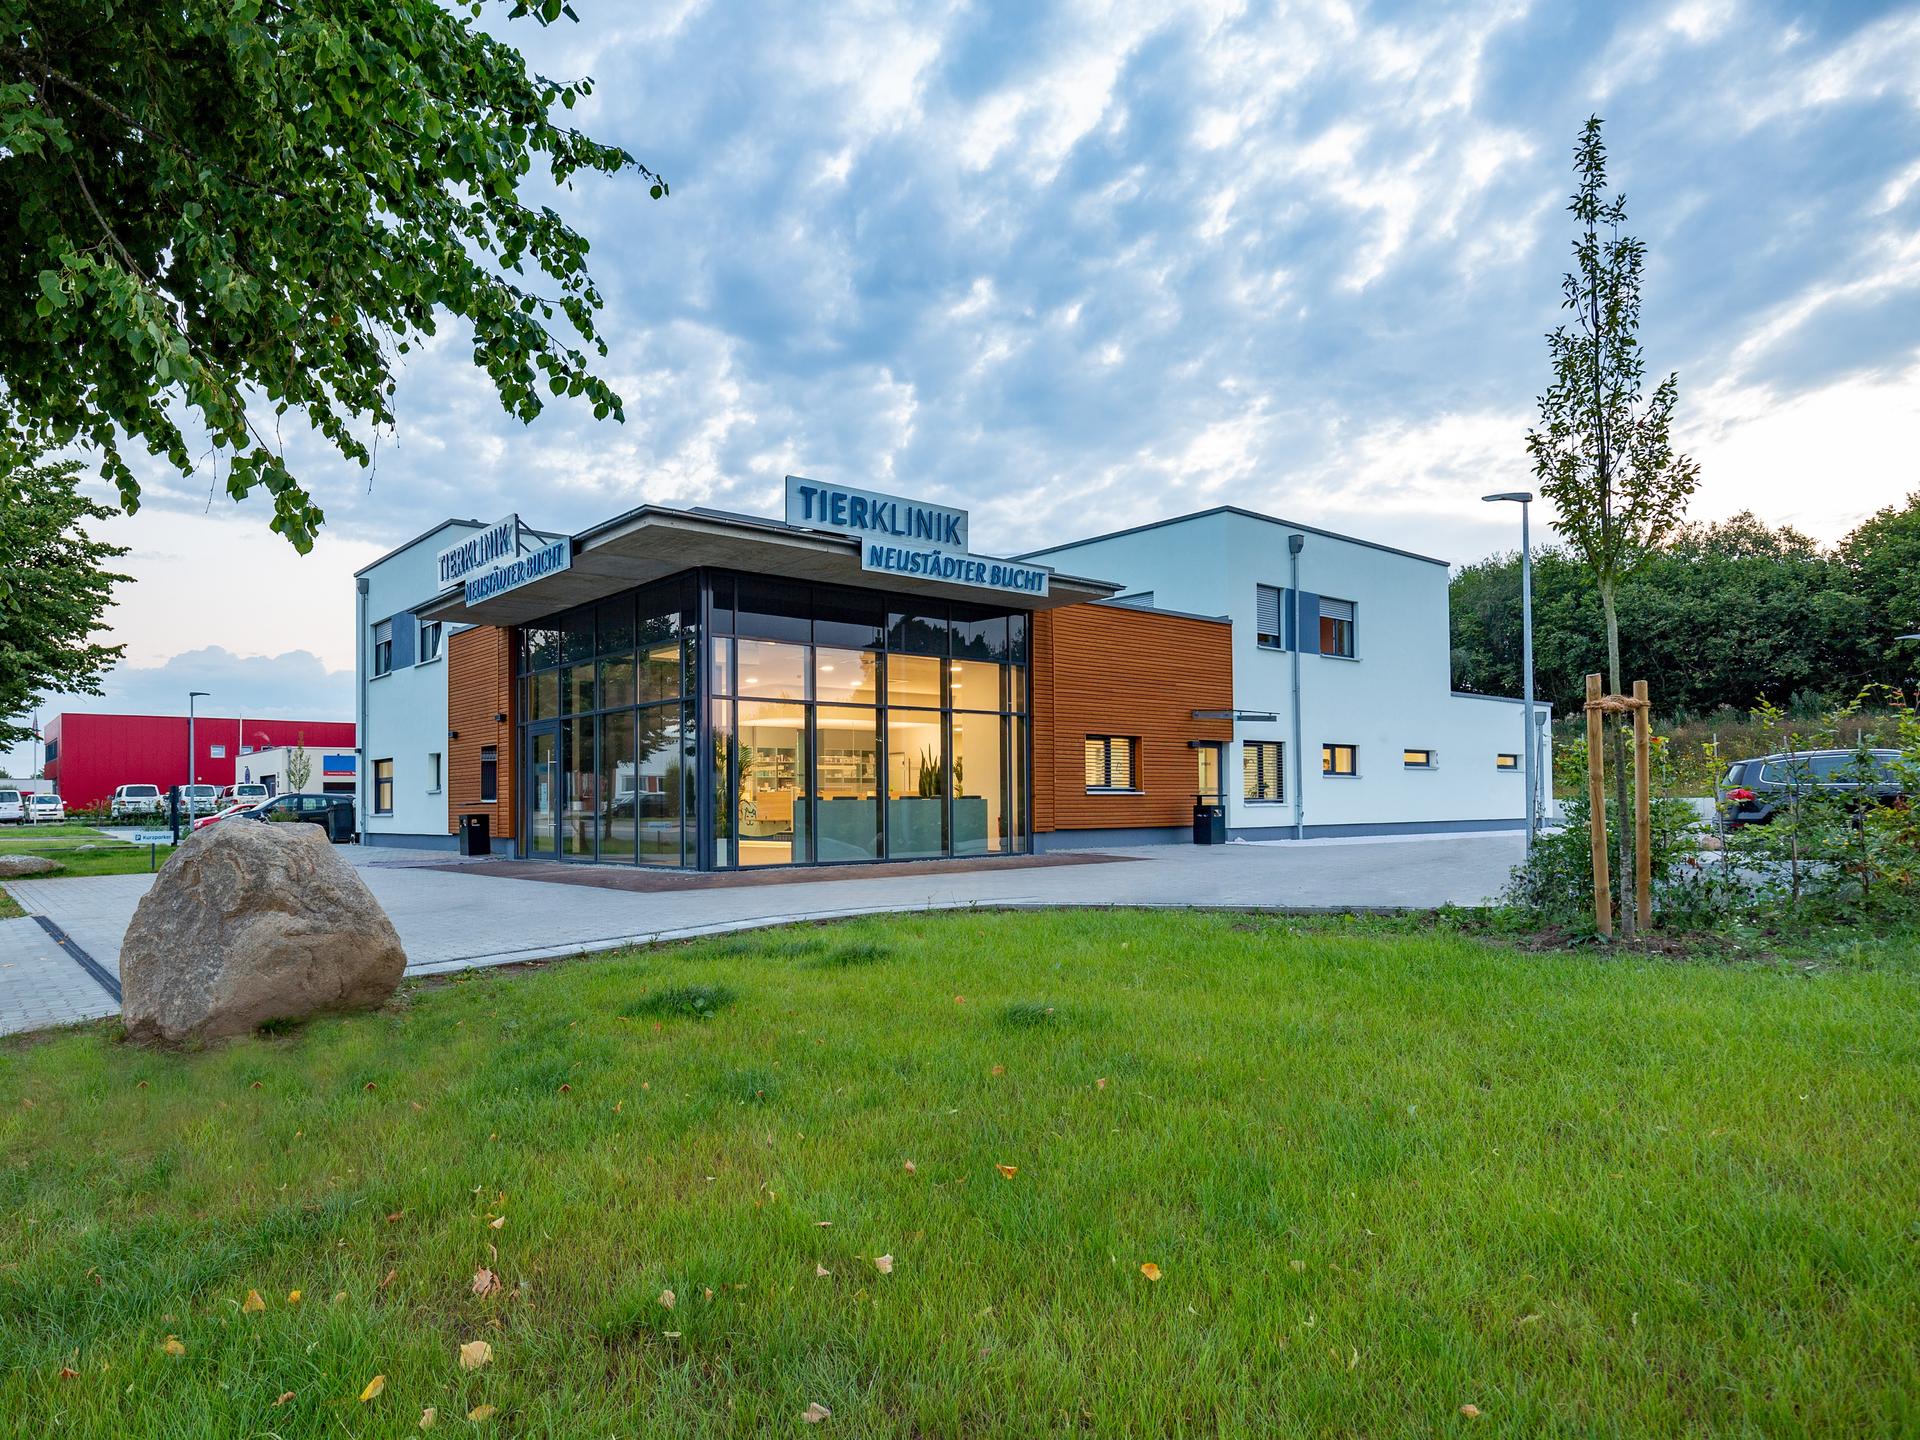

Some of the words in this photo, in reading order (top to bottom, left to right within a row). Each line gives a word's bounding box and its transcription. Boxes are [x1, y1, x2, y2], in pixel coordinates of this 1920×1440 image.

[799, 485, 962, 545] TIERKLINIK
[438, 523, 513, 582] TIERKLINIK
[465, 560, 526, 602] NEUSTÄDTER
[526, 542, 564, 579] BUCHT
[870, 544, 987, 584] NEUSTÄDTER
[990, 564, 1046, 592] BUCHT
